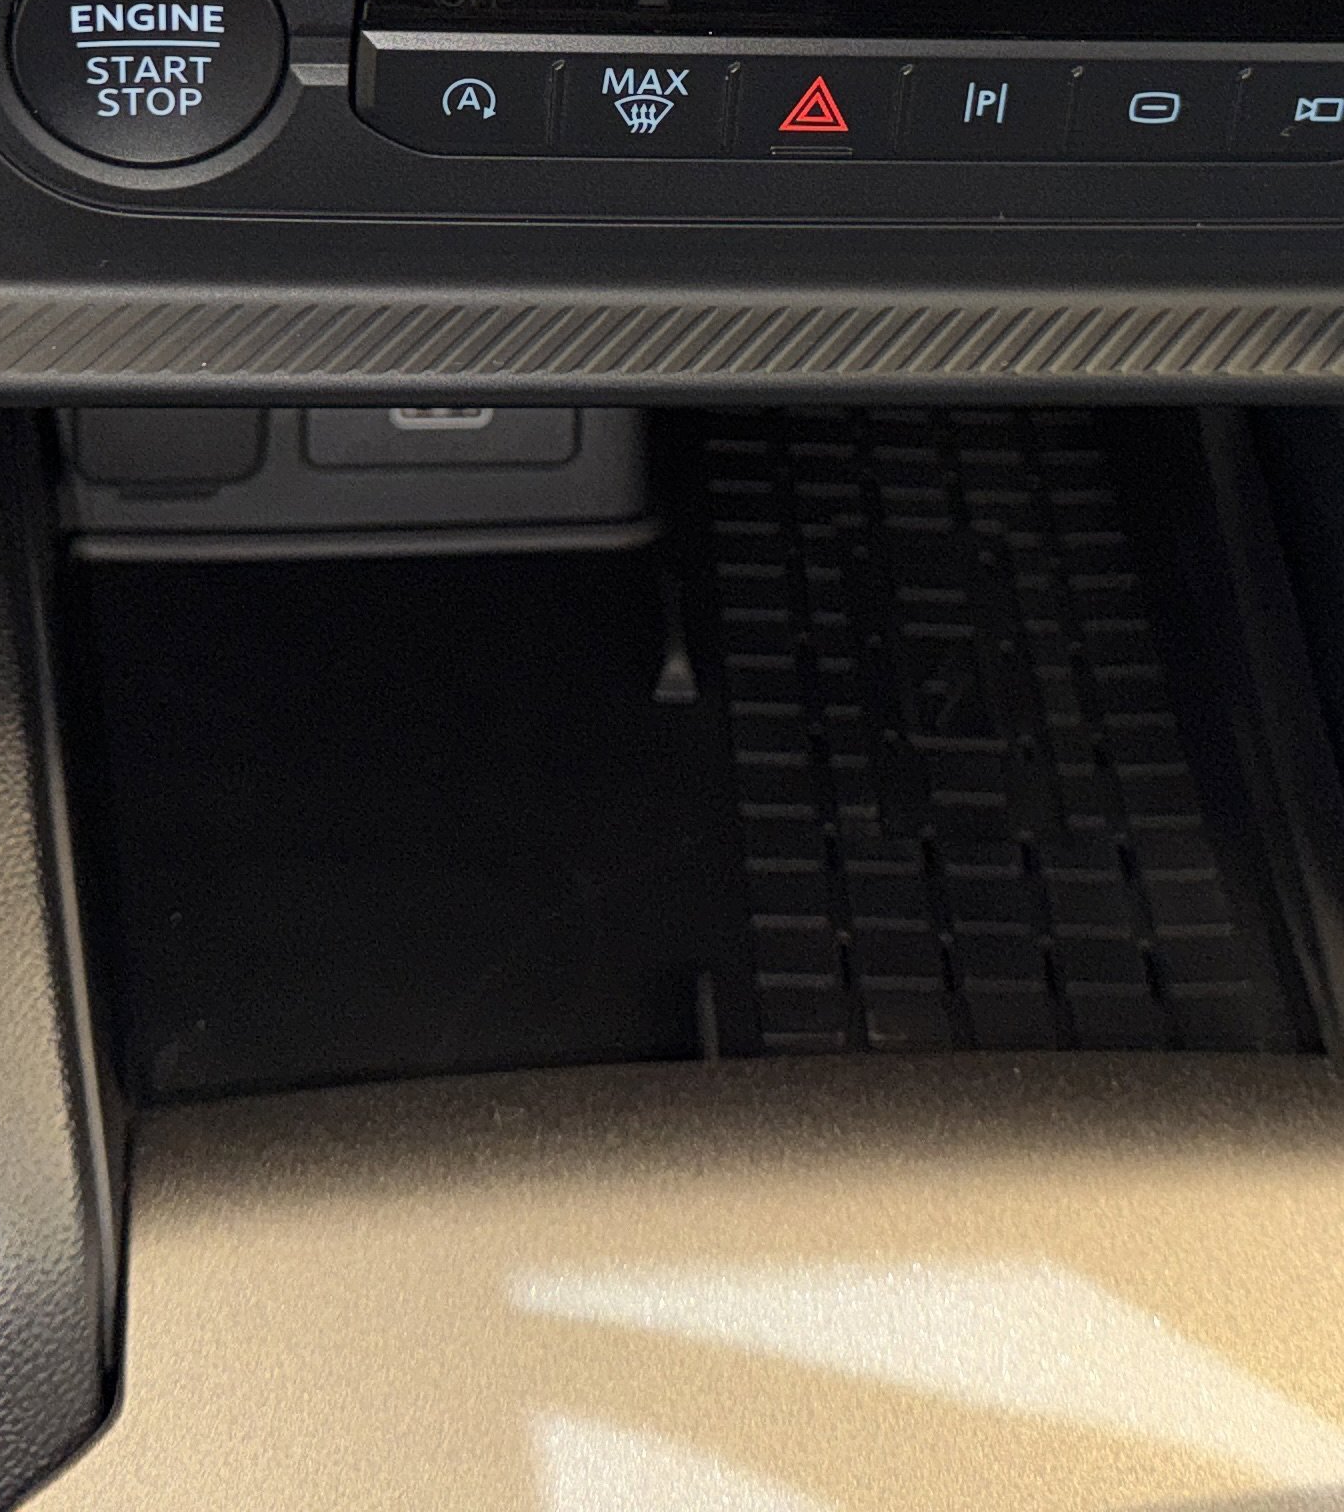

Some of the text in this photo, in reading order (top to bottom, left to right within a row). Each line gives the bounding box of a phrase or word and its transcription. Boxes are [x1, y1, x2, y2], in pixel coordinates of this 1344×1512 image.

[70, 3, 225, 35] ENGINE
[86, 55, 212, 86] START
[601, 66, 690, 97] MAX
[97, 86, 203, 118] STOP
